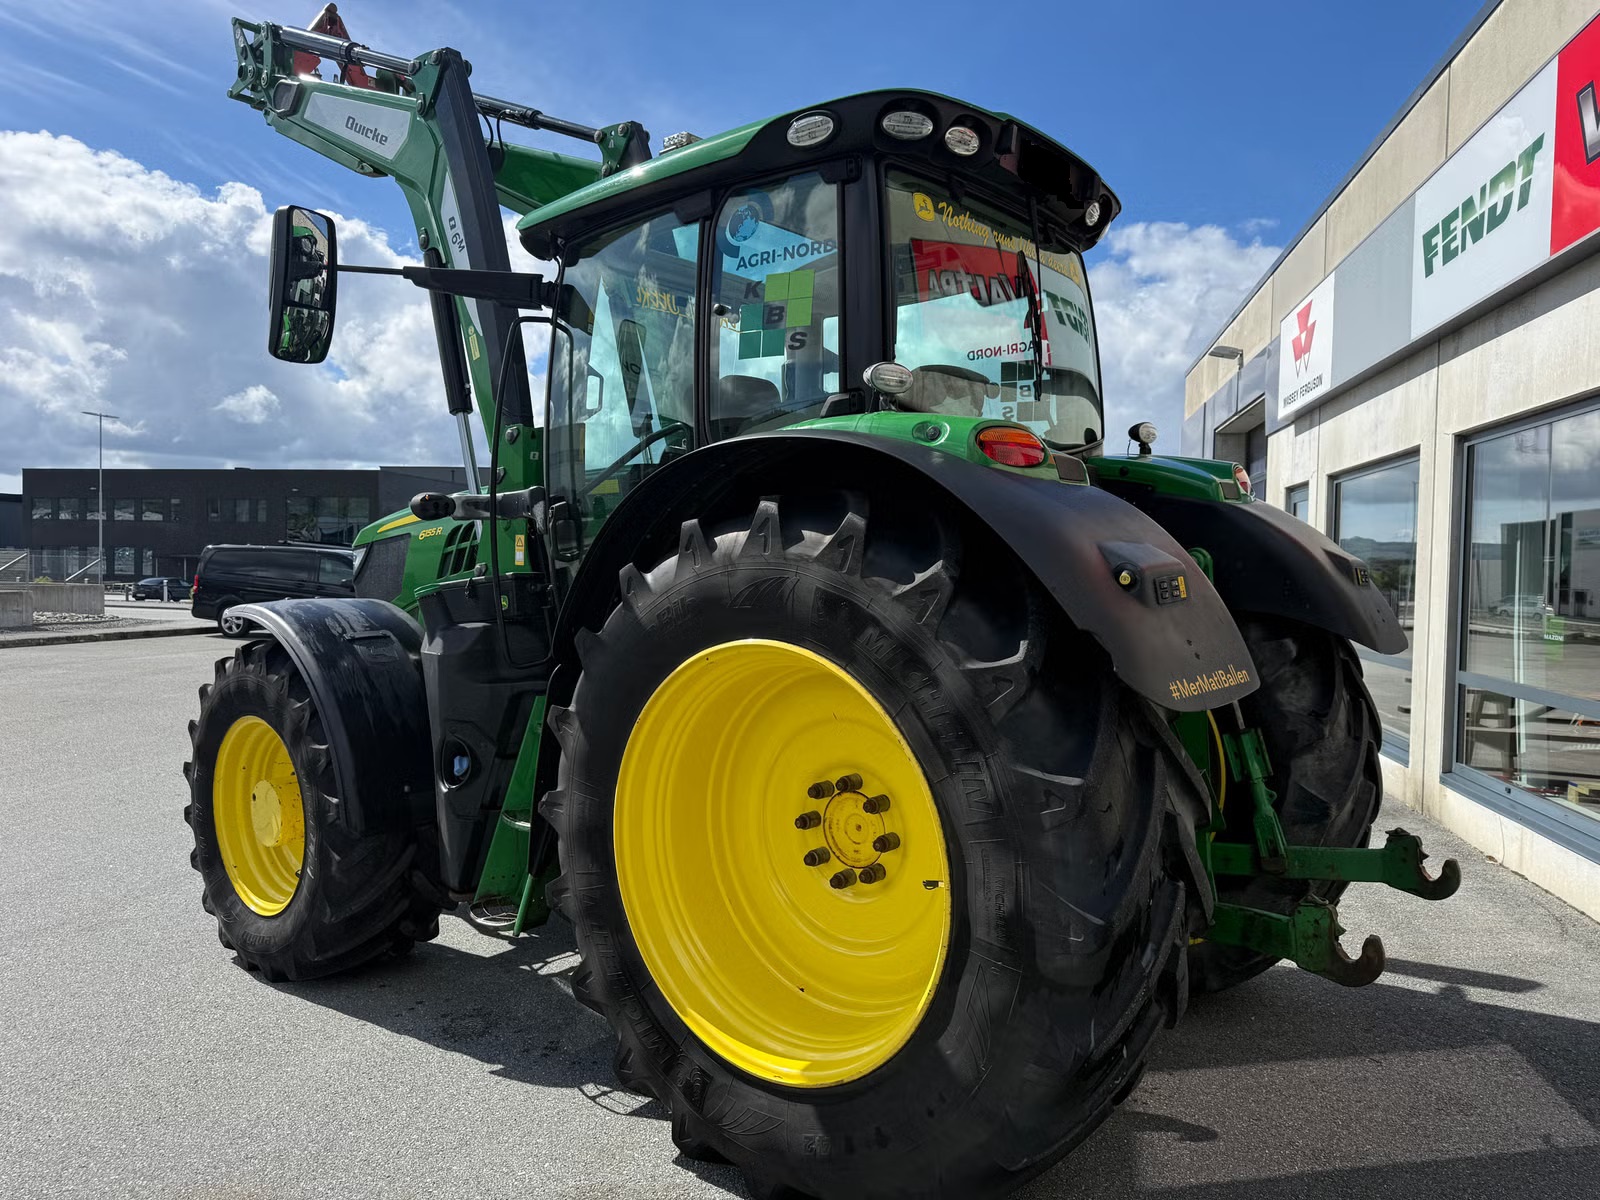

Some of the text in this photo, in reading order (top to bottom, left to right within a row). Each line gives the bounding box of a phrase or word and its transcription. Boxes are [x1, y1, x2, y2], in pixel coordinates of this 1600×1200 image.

[345, 115, 388, 146] Quicke
[938, 201, 989, 245] Nothing
[1422, 132, 1545, 278] FENDT
[736, 239, 837, 271] AGRI-NORD
